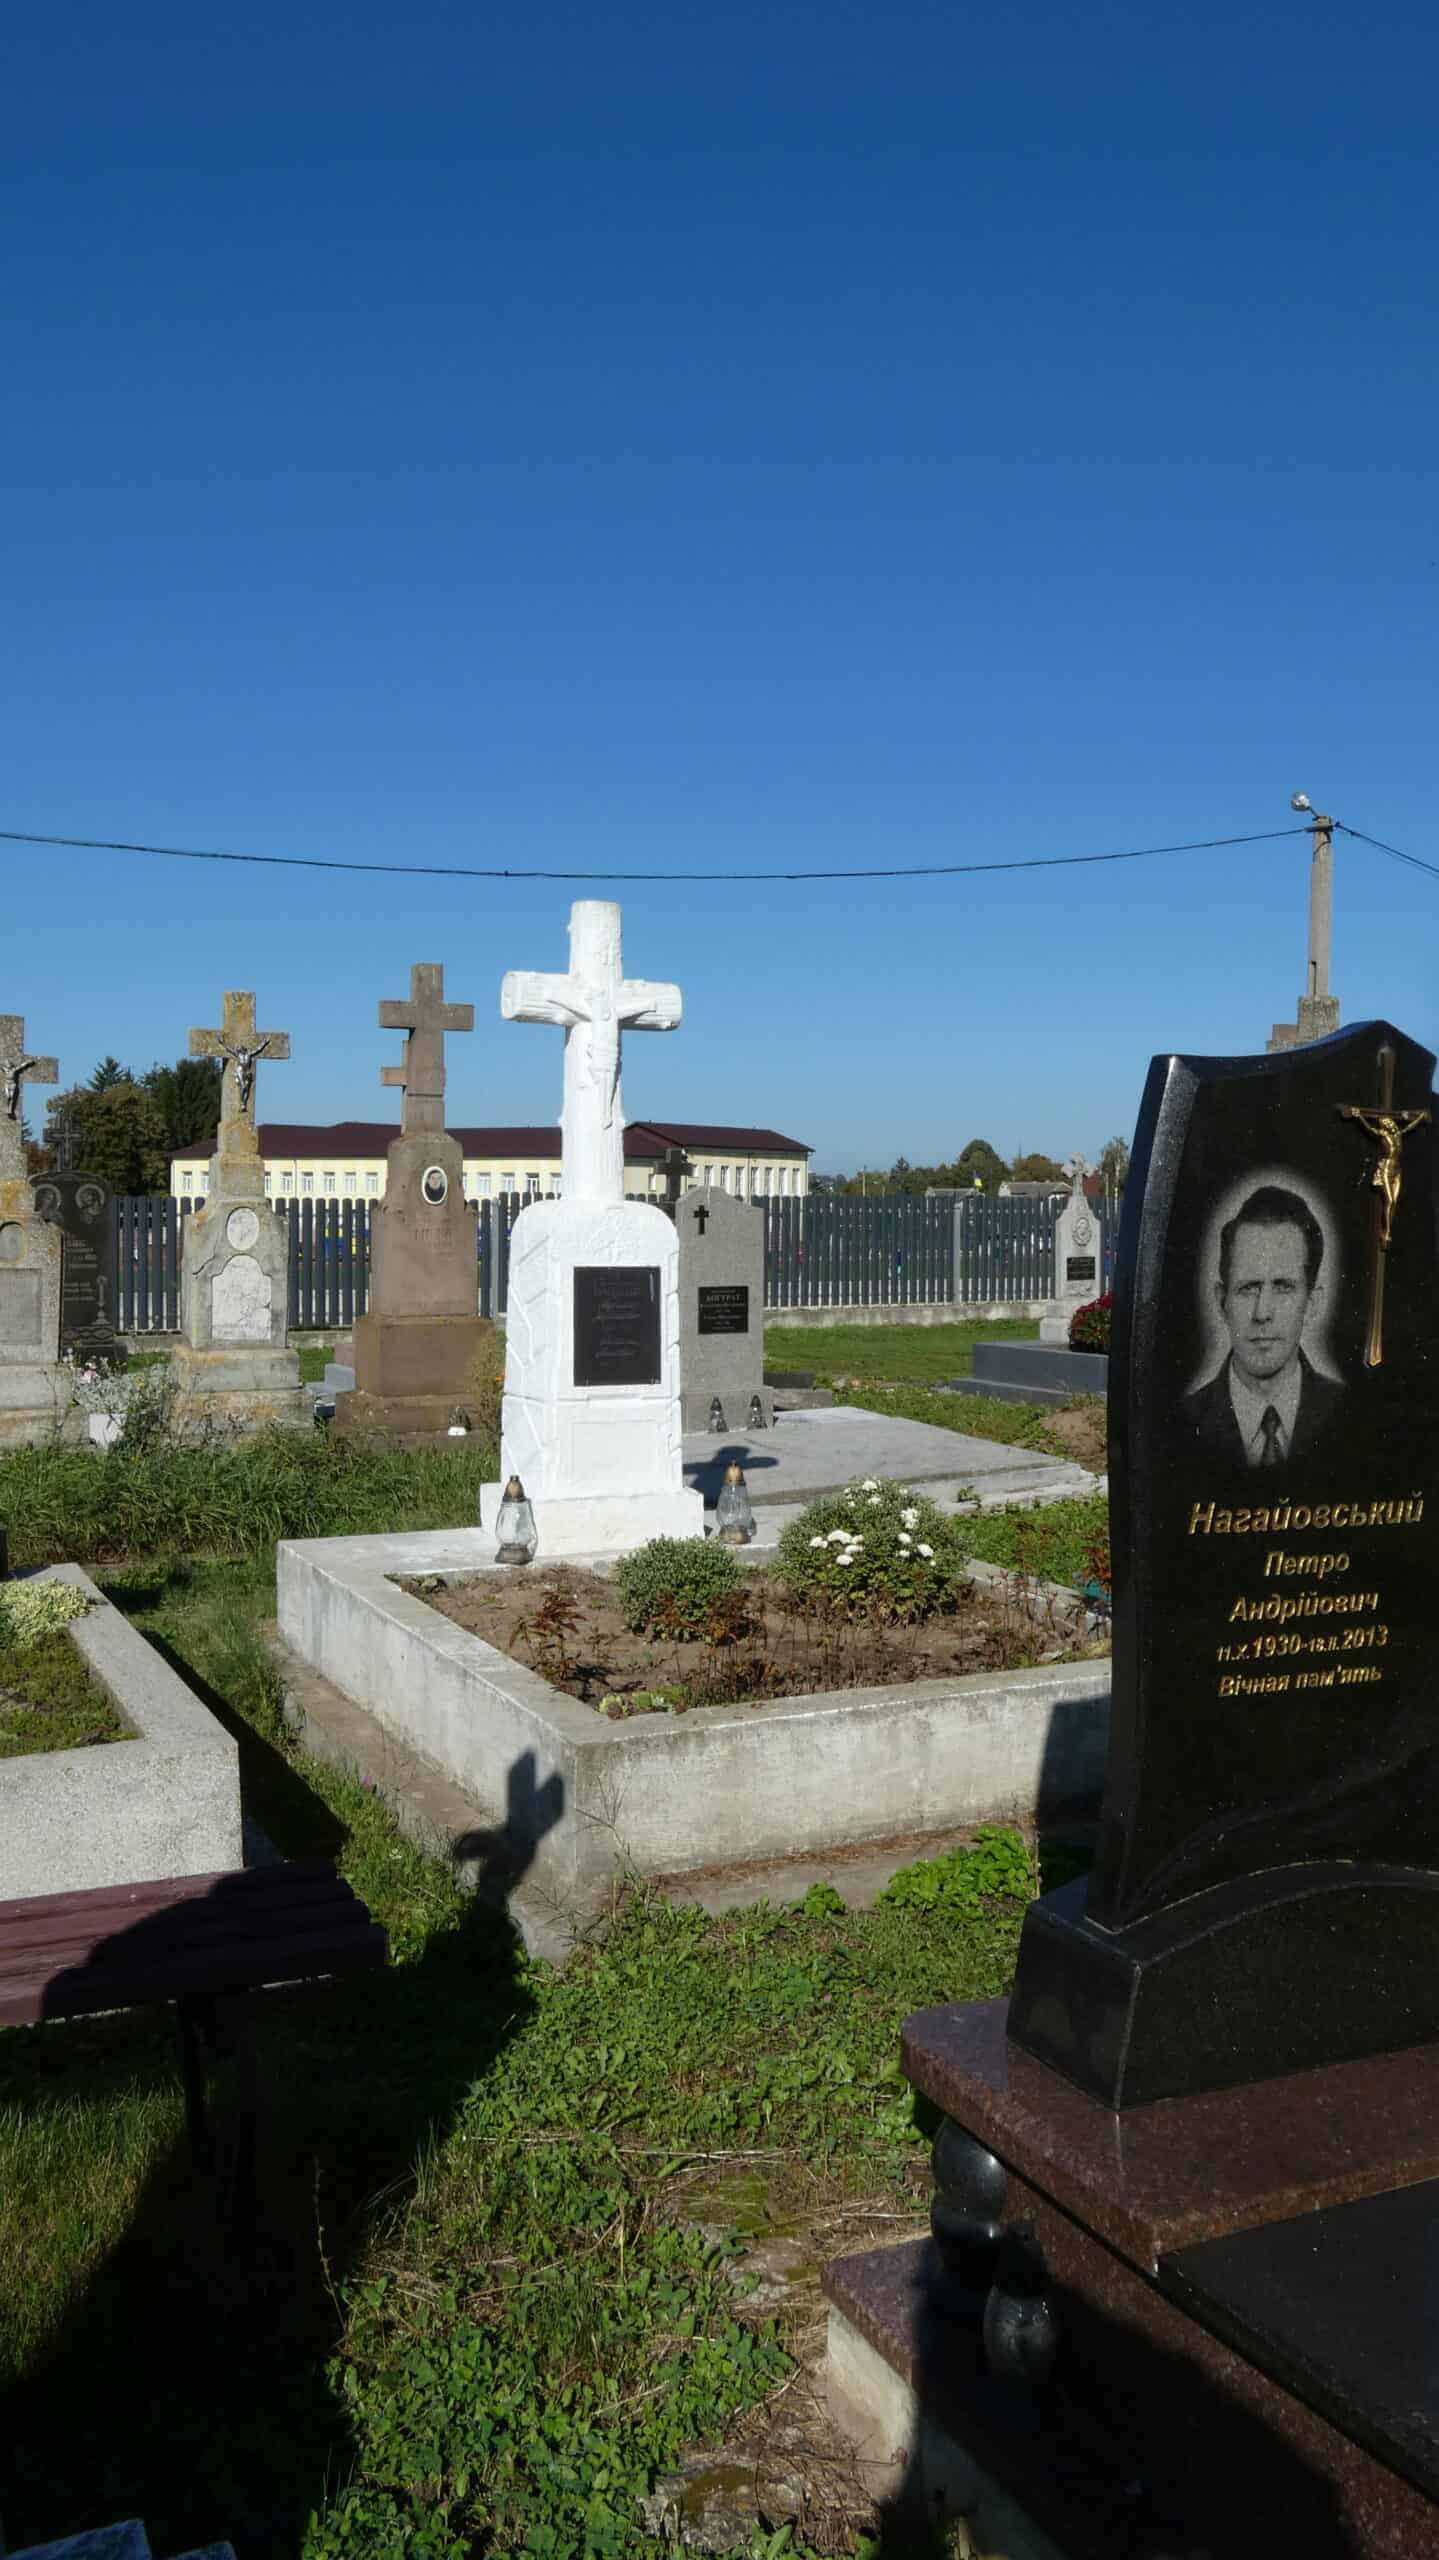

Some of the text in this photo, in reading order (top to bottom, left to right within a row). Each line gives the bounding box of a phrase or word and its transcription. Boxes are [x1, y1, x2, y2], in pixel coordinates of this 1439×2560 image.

[1188, 1490, 1424, 1535] Нагайовський
[1263, 1551, 1351, 1579] Петро
[1228, 1590, 1379, 1624] Андрійович
[1218, 1672, 1291, 1697] Вічная
